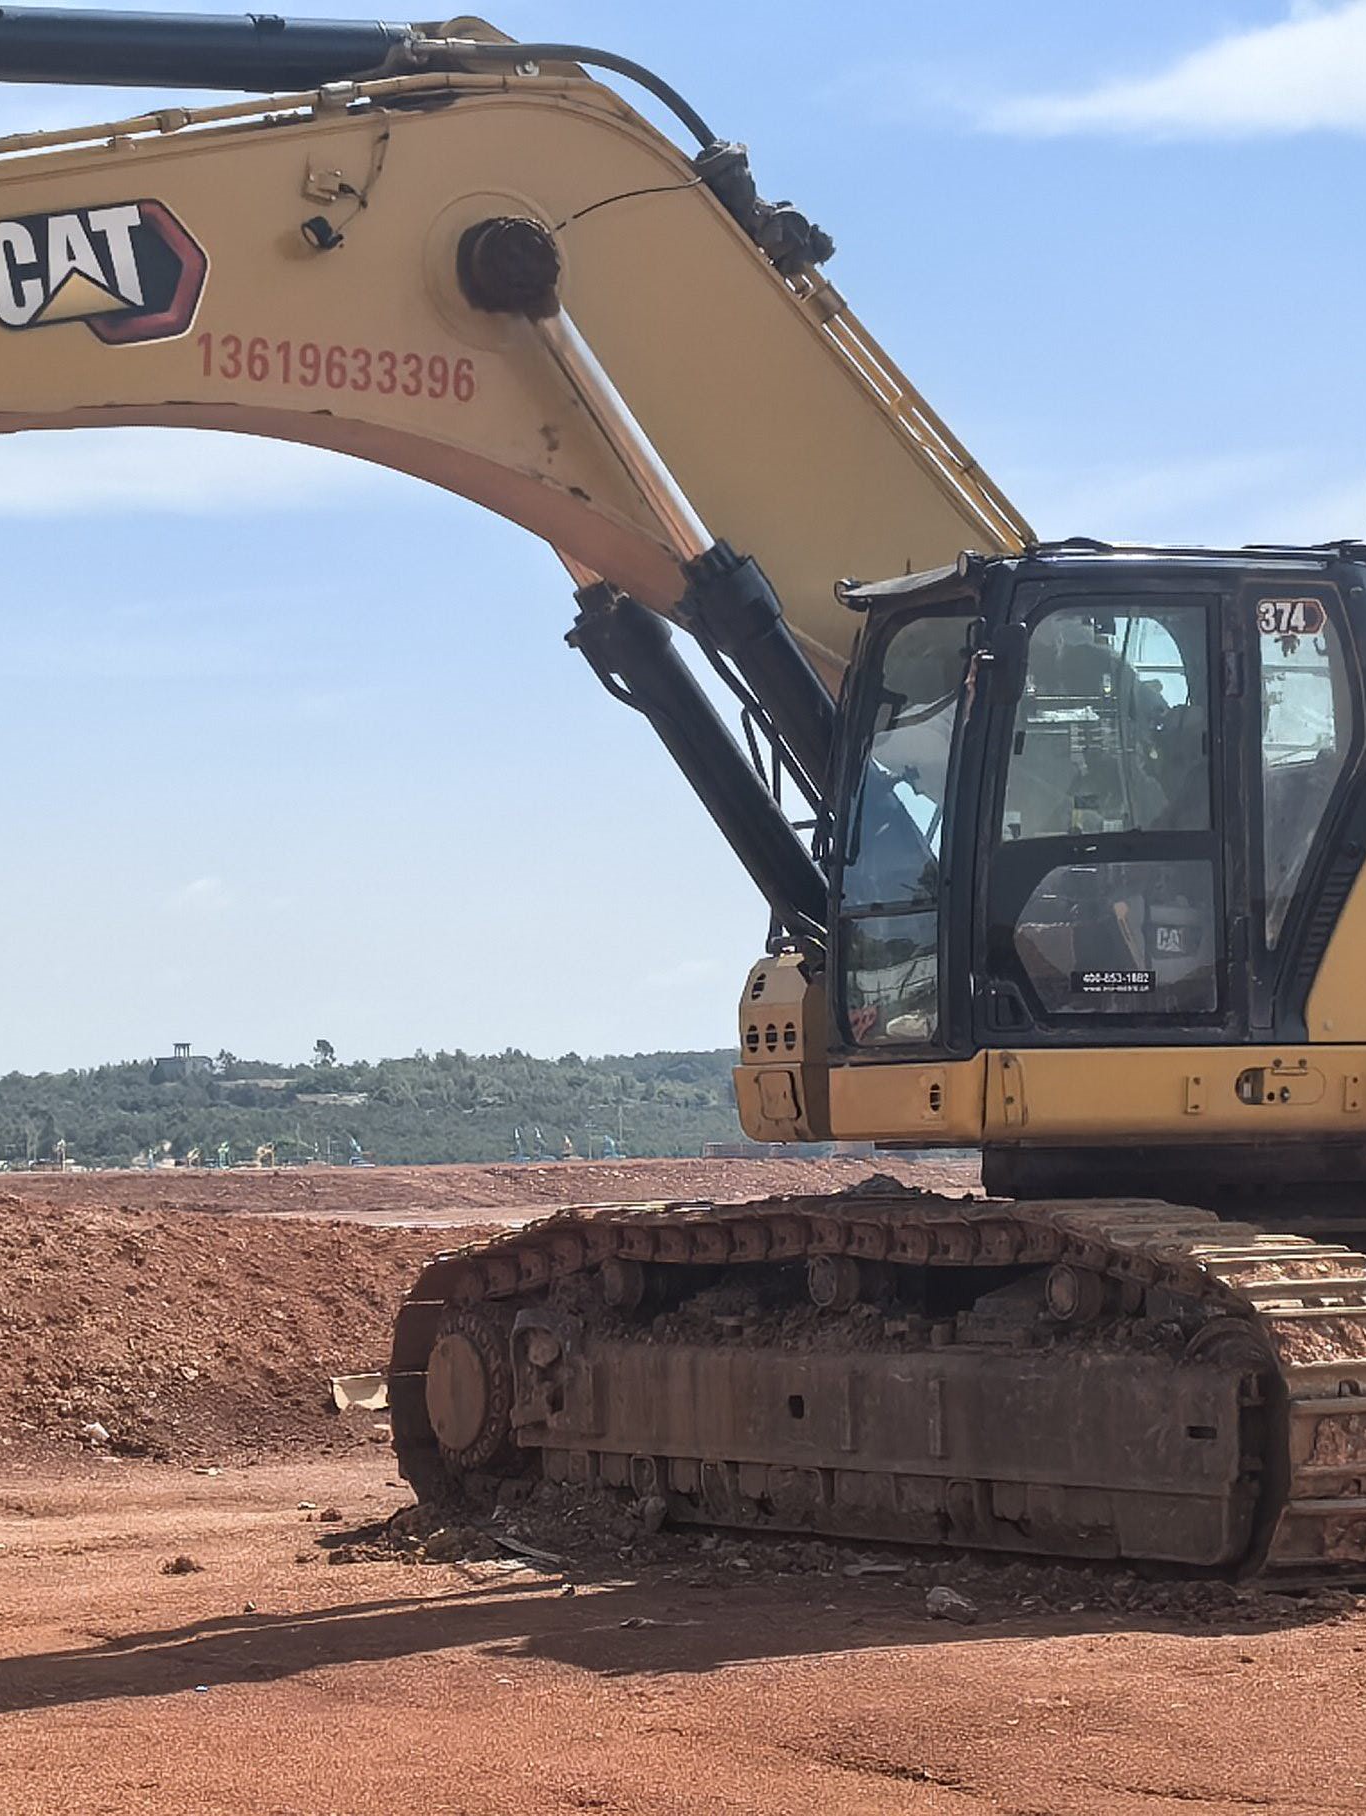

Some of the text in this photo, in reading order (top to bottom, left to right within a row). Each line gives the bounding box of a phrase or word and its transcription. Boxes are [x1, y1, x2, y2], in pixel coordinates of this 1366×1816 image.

[197, 331, 476, 403] 13619633396
[1259, 602, 1306, 632] 374
[1157, 927, 1185, 952] CA
